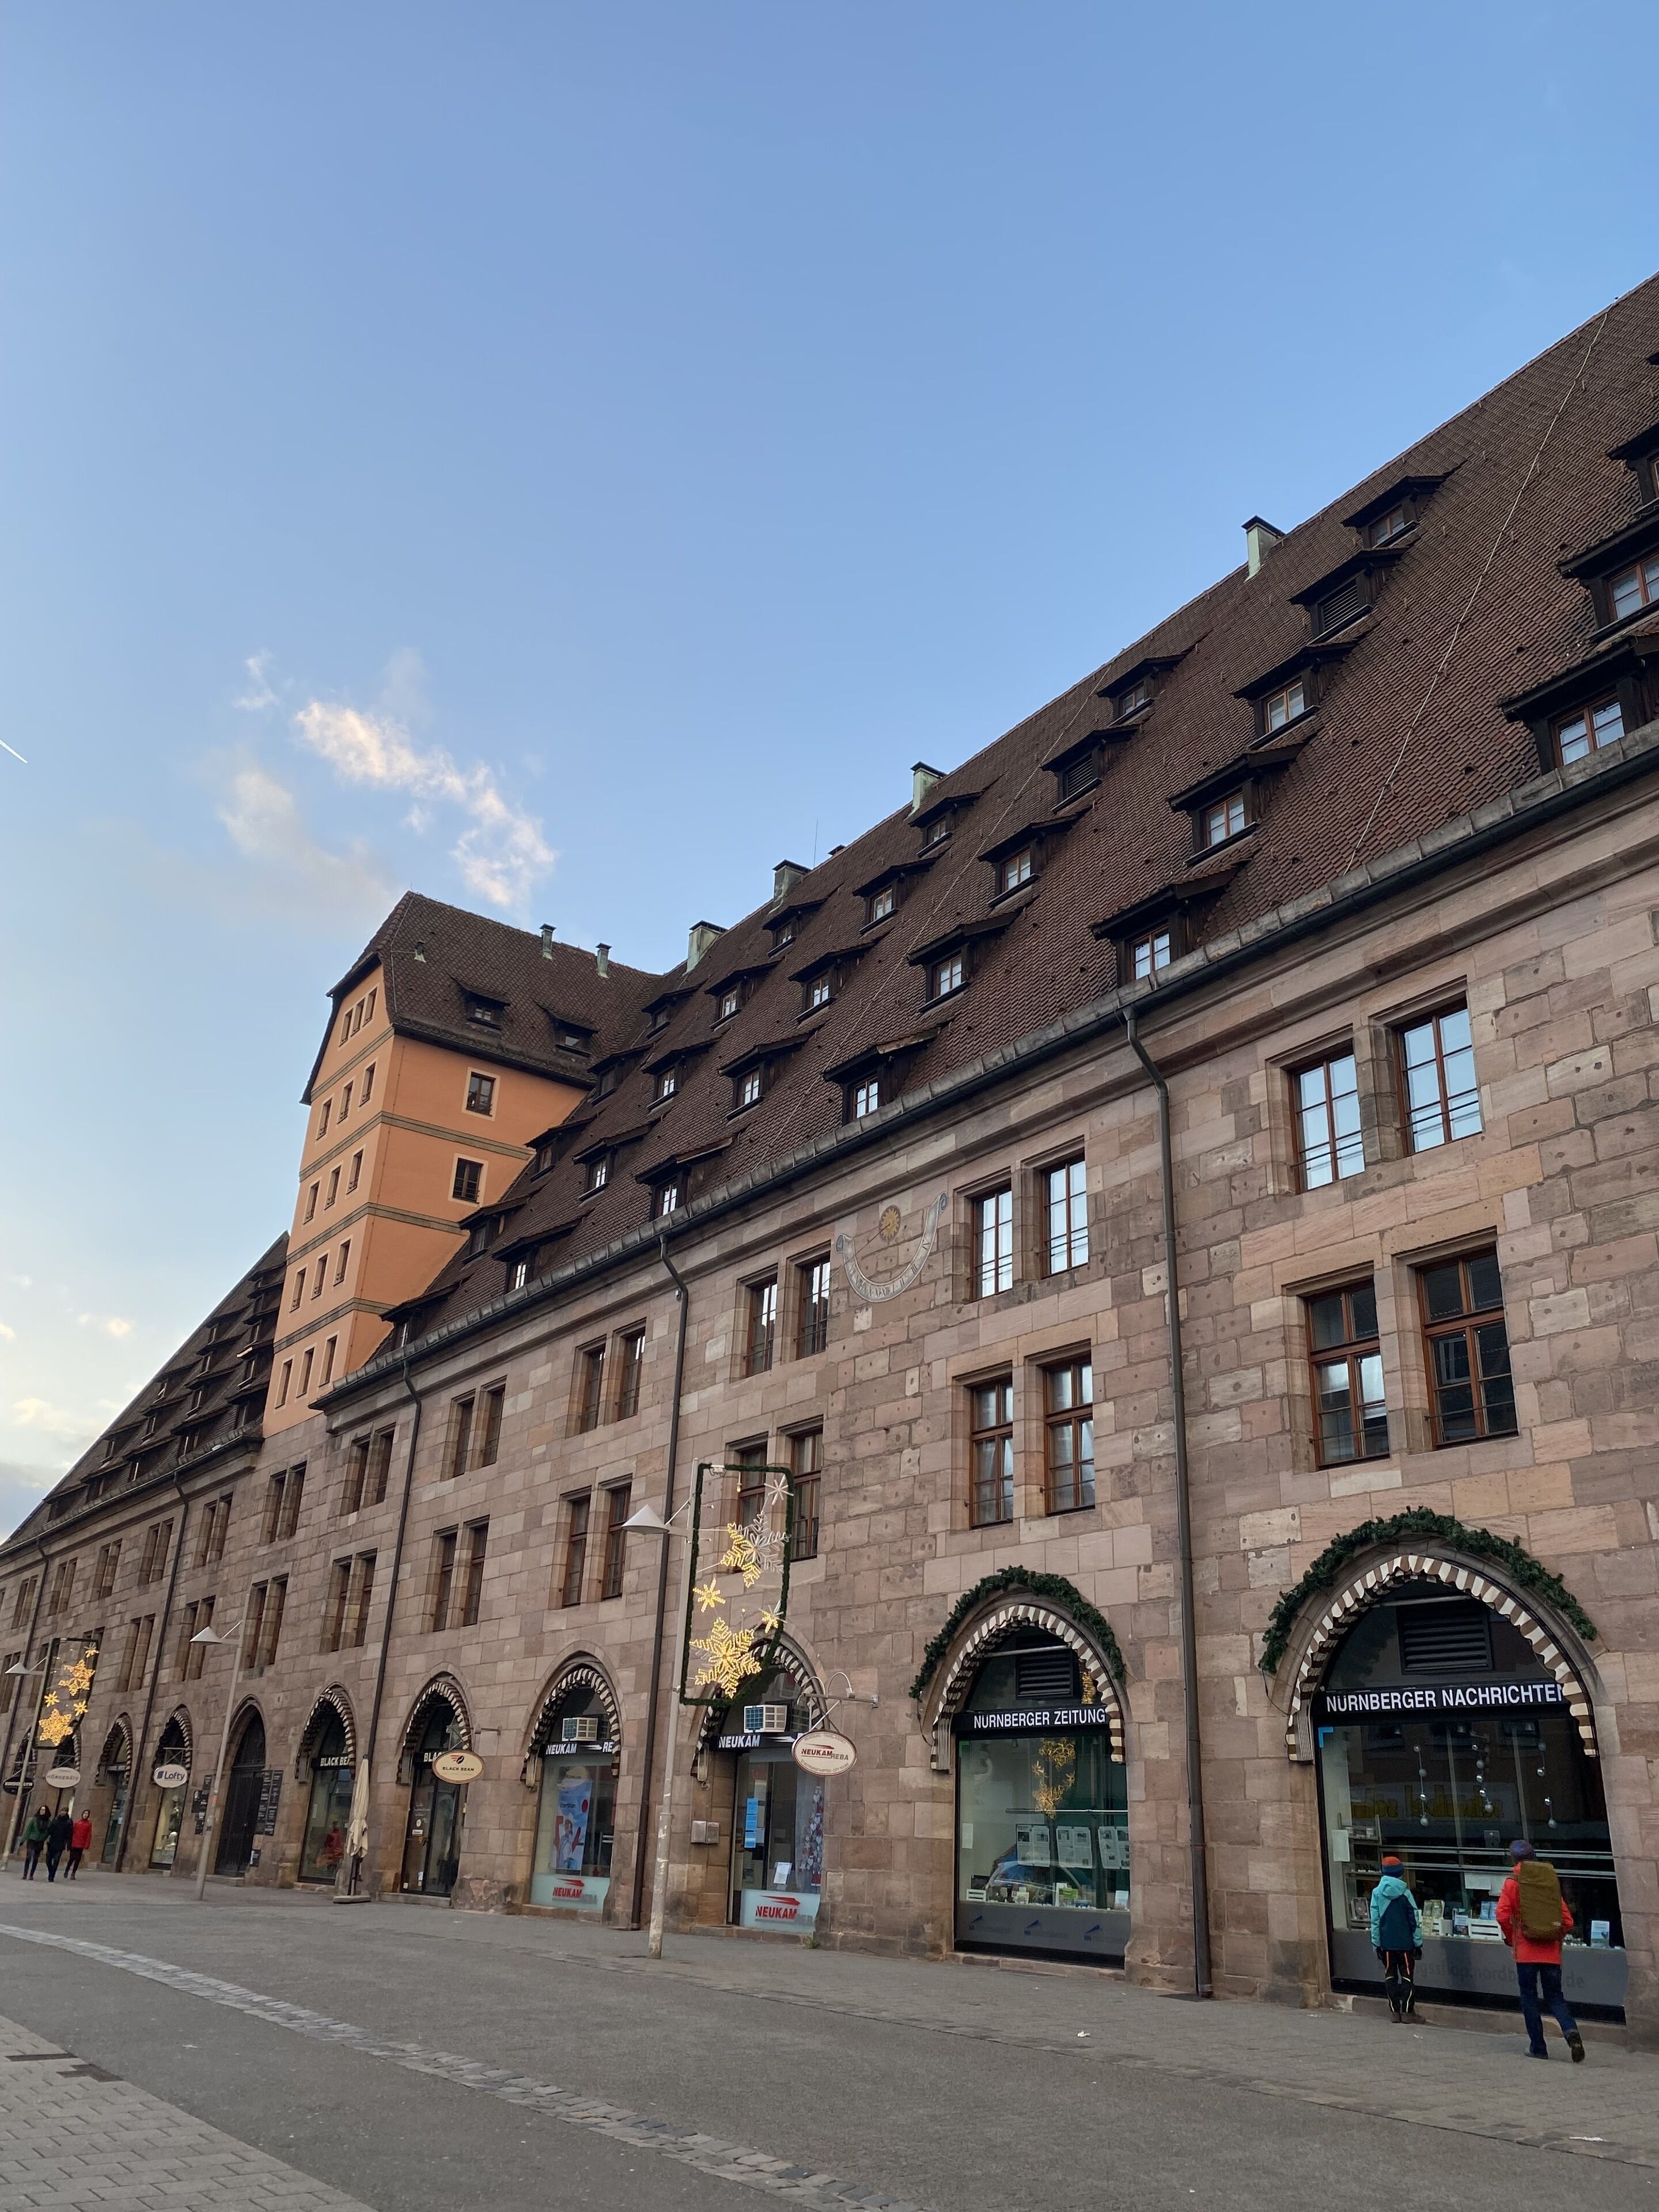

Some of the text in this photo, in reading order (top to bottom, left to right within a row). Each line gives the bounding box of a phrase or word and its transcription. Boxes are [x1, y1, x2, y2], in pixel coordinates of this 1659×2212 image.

[910, 1263, 918, 1275] III
[1325, 1690, 1437, 1712] NÜRNBERGER
[1054, 1707, 1105, 1725] ZEITUNG
[718, 1734, 761, 1748] NEUKAM
[546, 1743, 577, 1755] NEUKAM
[801, 1748, 832, 1757] NEUKAM
[320, 1756, 339, 1767] BLACK
[164, 1771, 185, 1781] Lofty
[552, 1887, 582, 1899] NEUKAM
[755, 1905, 797, 1919] NEUKAM
